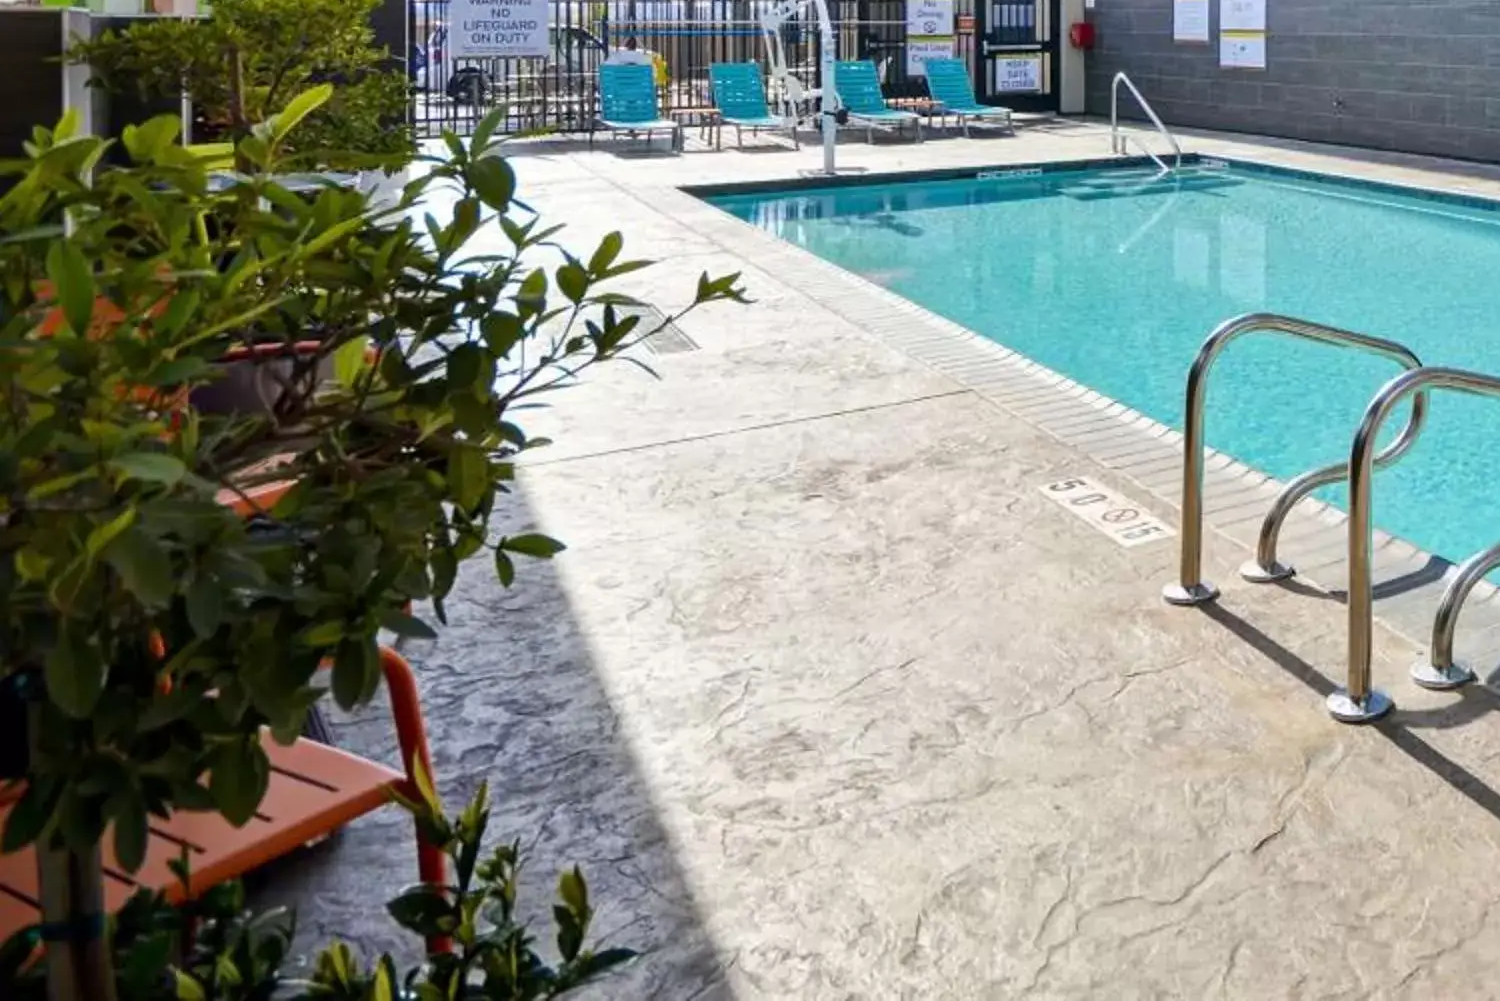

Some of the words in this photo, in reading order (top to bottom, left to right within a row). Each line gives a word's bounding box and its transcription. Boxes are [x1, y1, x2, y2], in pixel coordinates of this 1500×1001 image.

[490, 8, 510, 18] NO
[463, 20, 537, 31] LIFEGUARD
[471, 33, 490, 44] ON
[495, 33, 530, 44] DUTY
